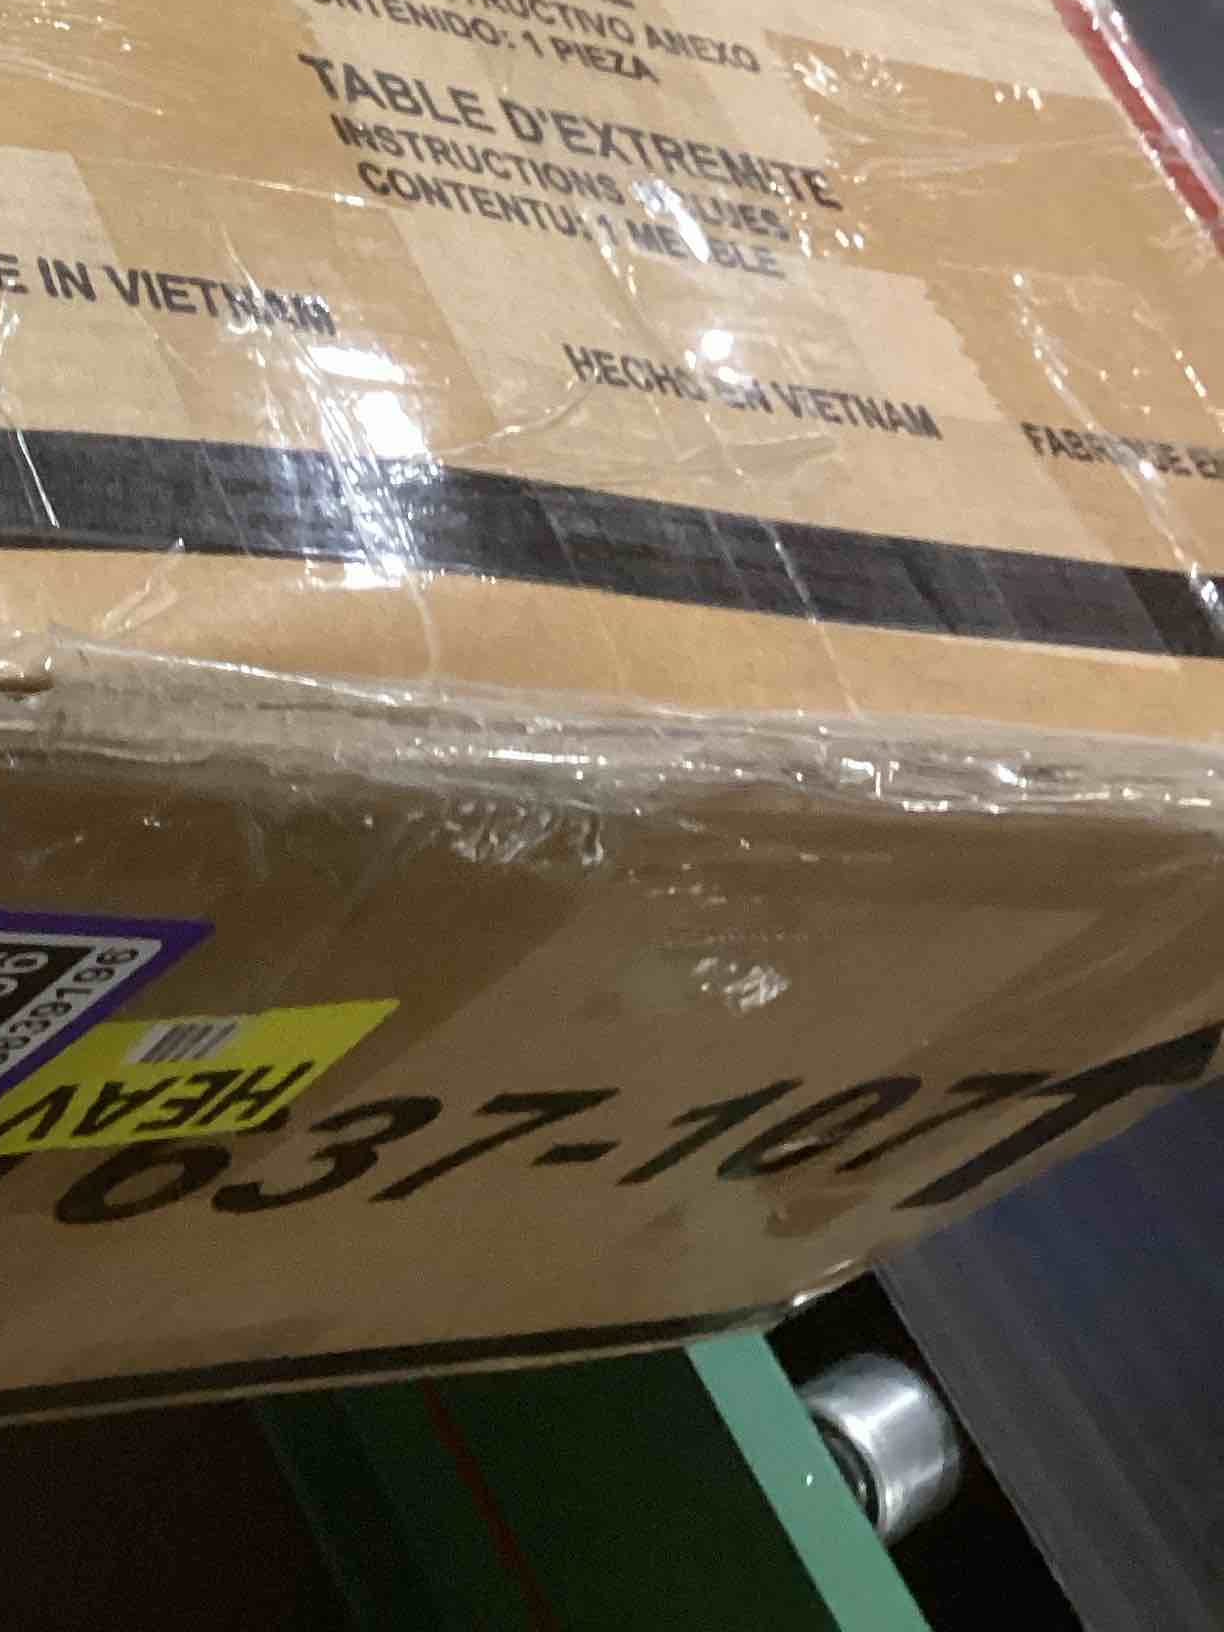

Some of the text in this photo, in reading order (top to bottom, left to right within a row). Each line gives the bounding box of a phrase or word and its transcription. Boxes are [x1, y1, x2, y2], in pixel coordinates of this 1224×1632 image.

[522, 30, 546, 60] 1
[552, 33, 660, 85] PIEZA
[644, 24, 761, 75] ANEXO
[297, 52, 497, 136] TABLE
[329, 112, 625, 206] INSTRUCTIONS
[625, 218, 786, 280] MEBLE
[36, 254, 98, 302] IN
[102, 265, 337, 337] VIETNAM
[561, 342, 709, 403] HECHO
[769, 380, 944, 442] VIETNAM
